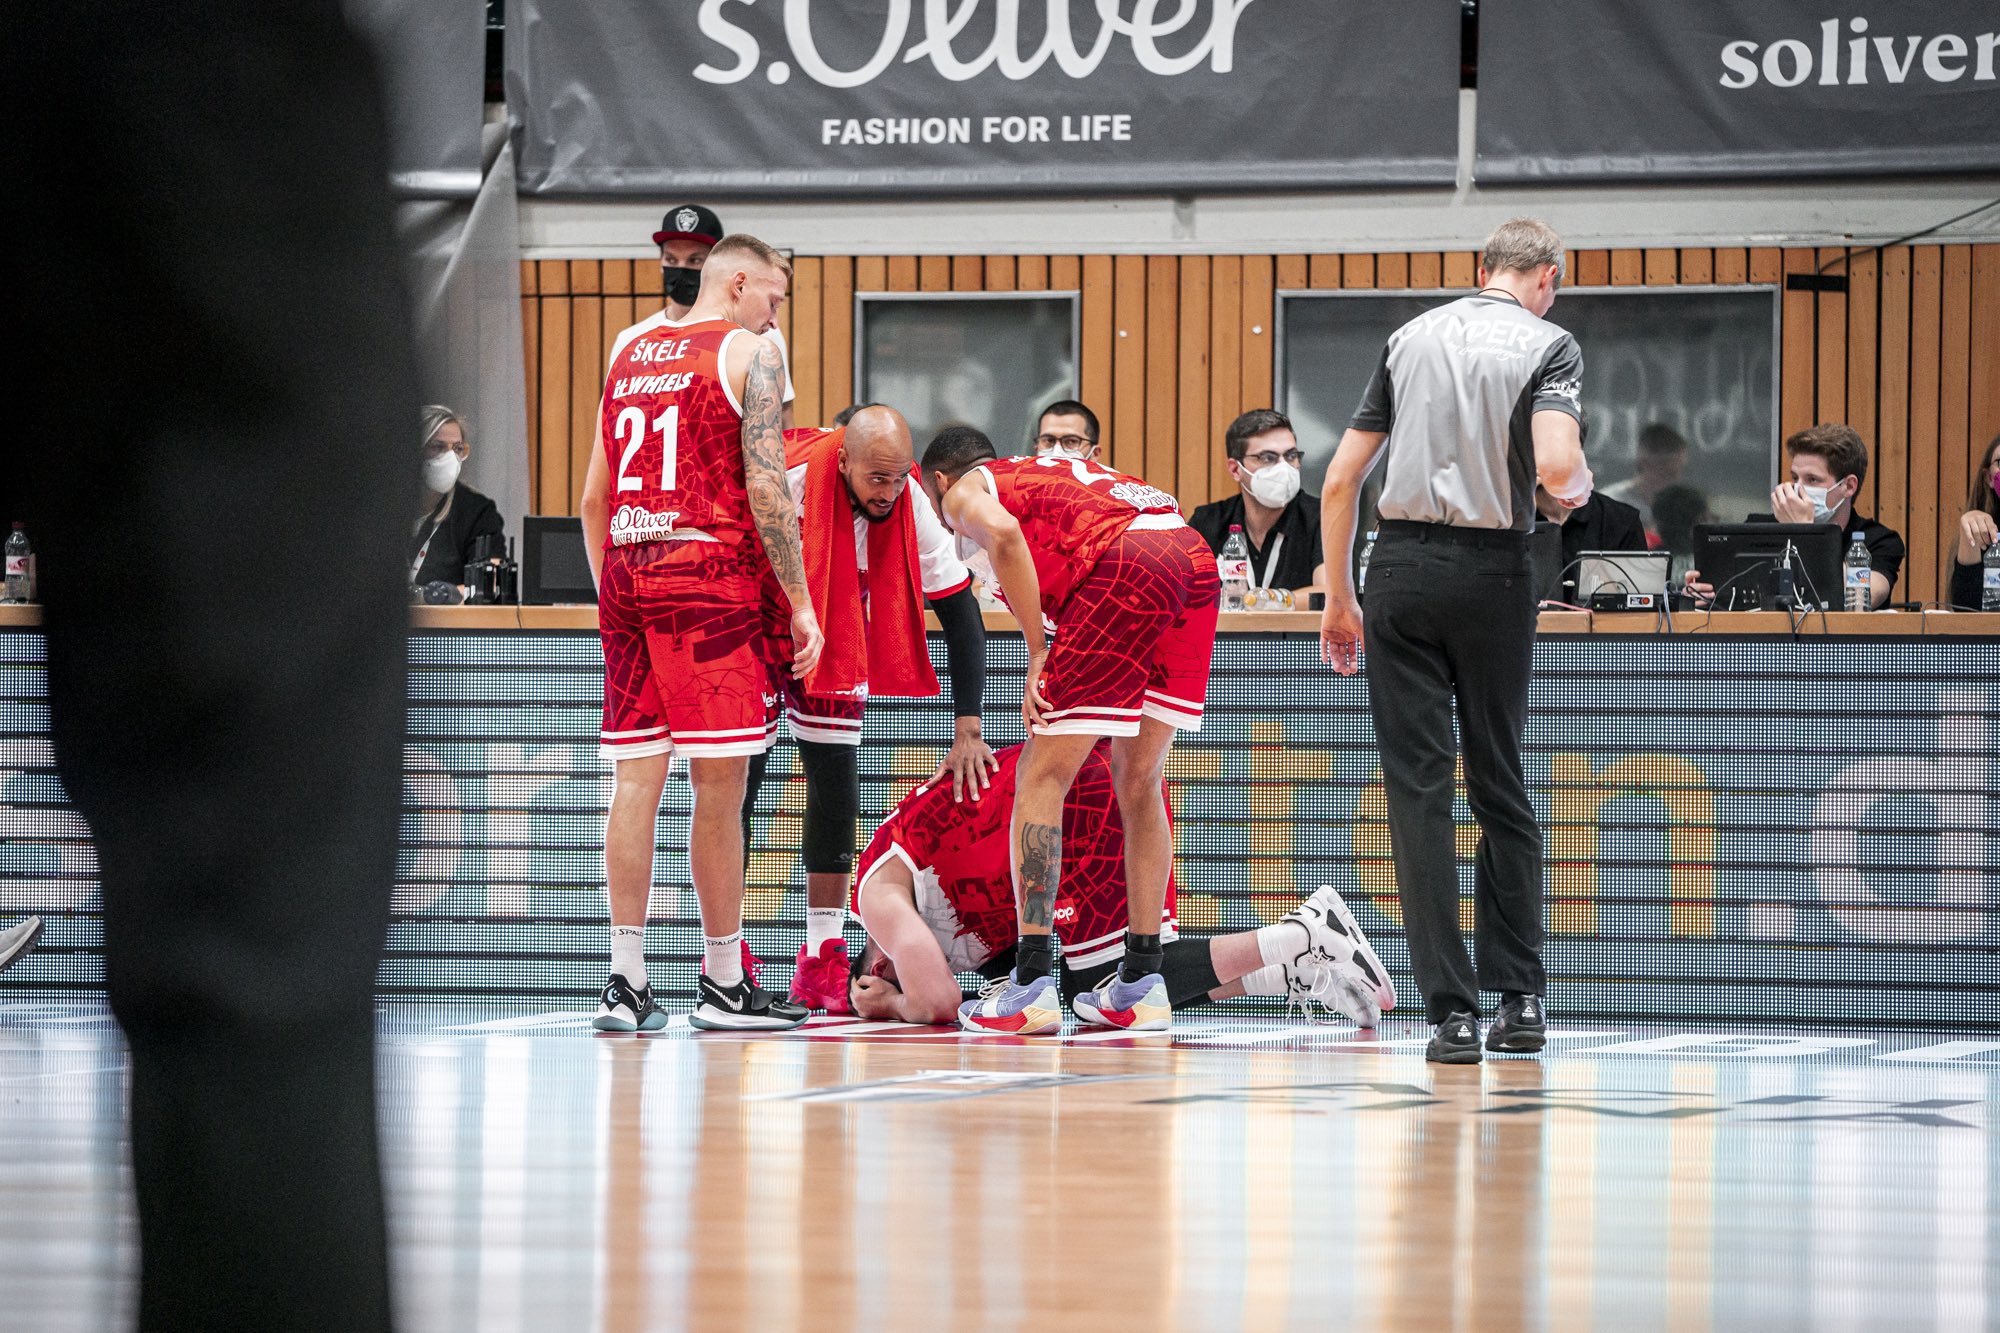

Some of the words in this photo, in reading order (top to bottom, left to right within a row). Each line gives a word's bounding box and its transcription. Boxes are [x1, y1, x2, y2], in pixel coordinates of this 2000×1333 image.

[1719, 16, 2000, 89] soliver
[821, 117, 971, 145] FASHION
[982, 116, 1051, 143] FOR
[1061, 114, 1132, 142] LIFE
[614, 405, 679, 495] 21
